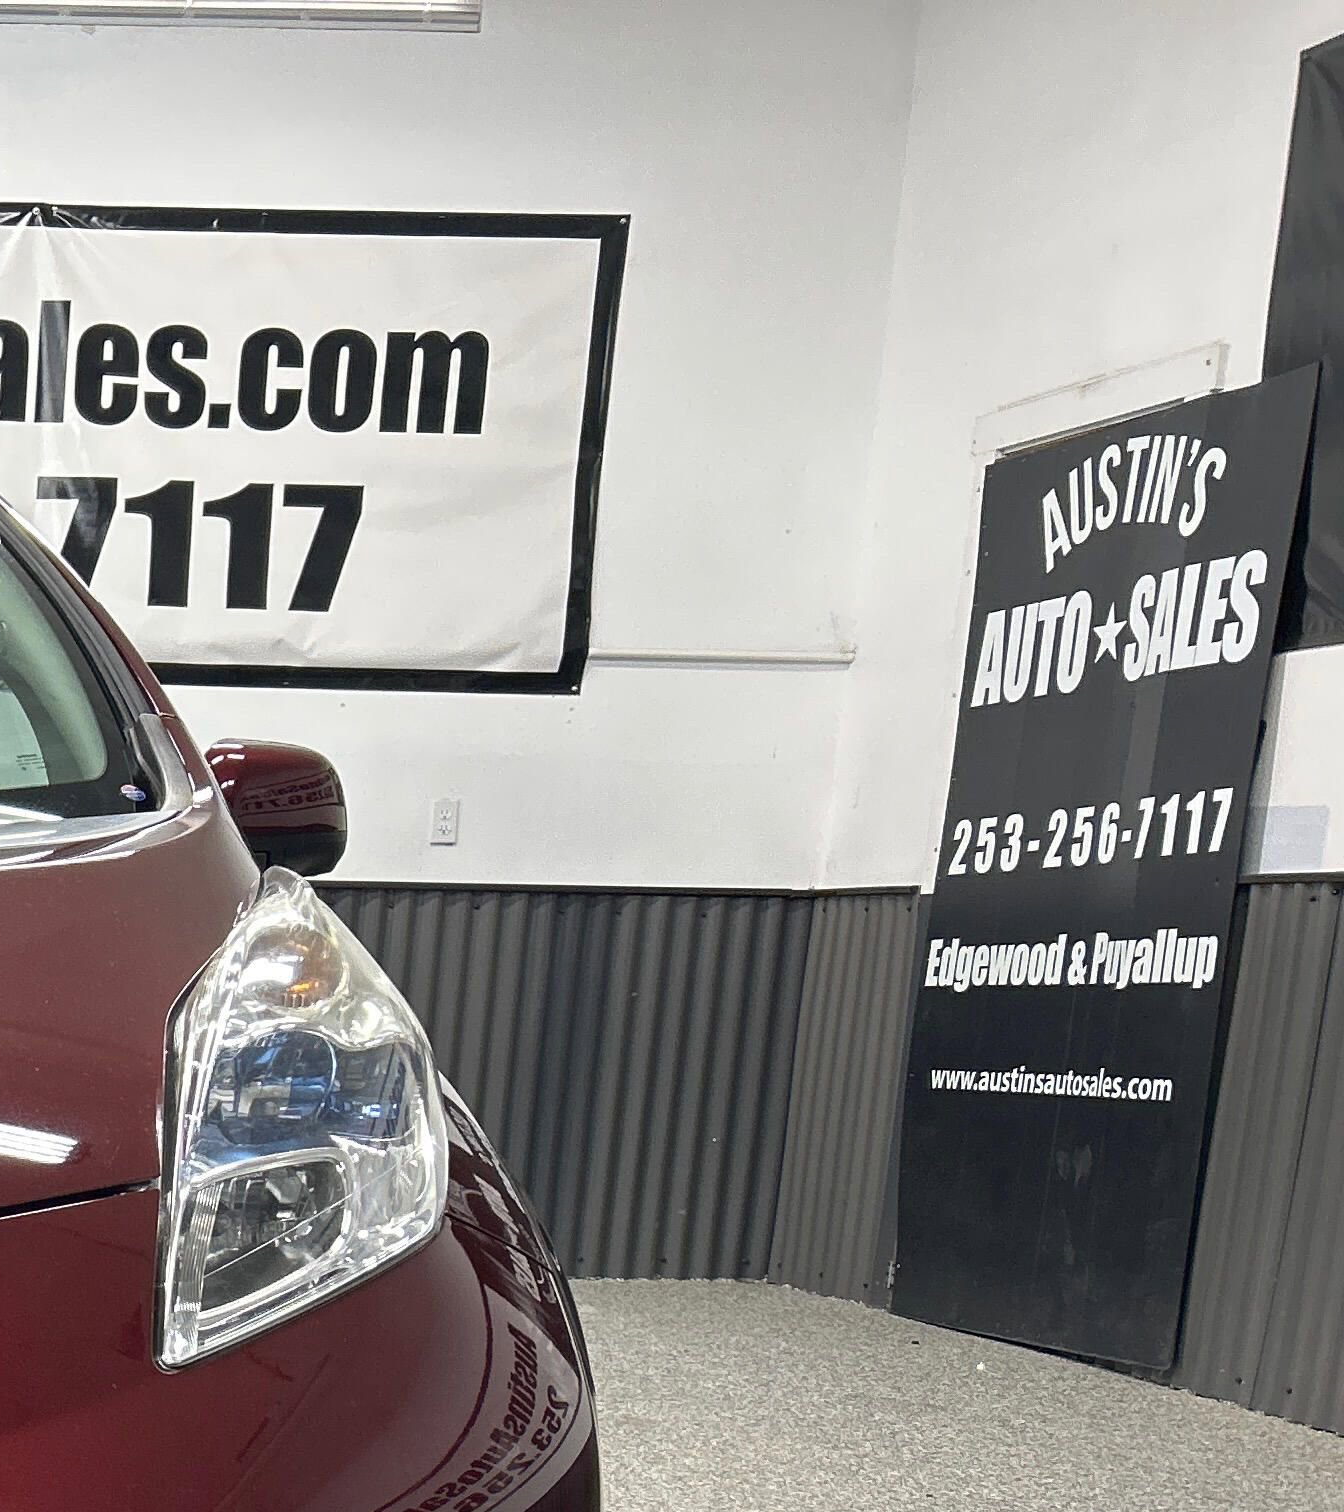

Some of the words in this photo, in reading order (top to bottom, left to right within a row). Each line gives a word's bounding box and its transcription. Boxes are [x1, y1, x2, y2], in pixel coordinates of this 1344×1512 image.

[1042, 434, 1226, 573] AUSTIN'S
[970, 590, 1093, 708] AUTO
[1123, 549, 1268, 682] SALES
[947, 787, 1234, 876] 253-256-7117
[924, 934, 1066, 992] Edgewood
[1067, 939, 1088, 986] &
[1089, 928, 1218, 989] Puyallup
[930, 1065, 1173, 1102] www.austinsautosales.com
